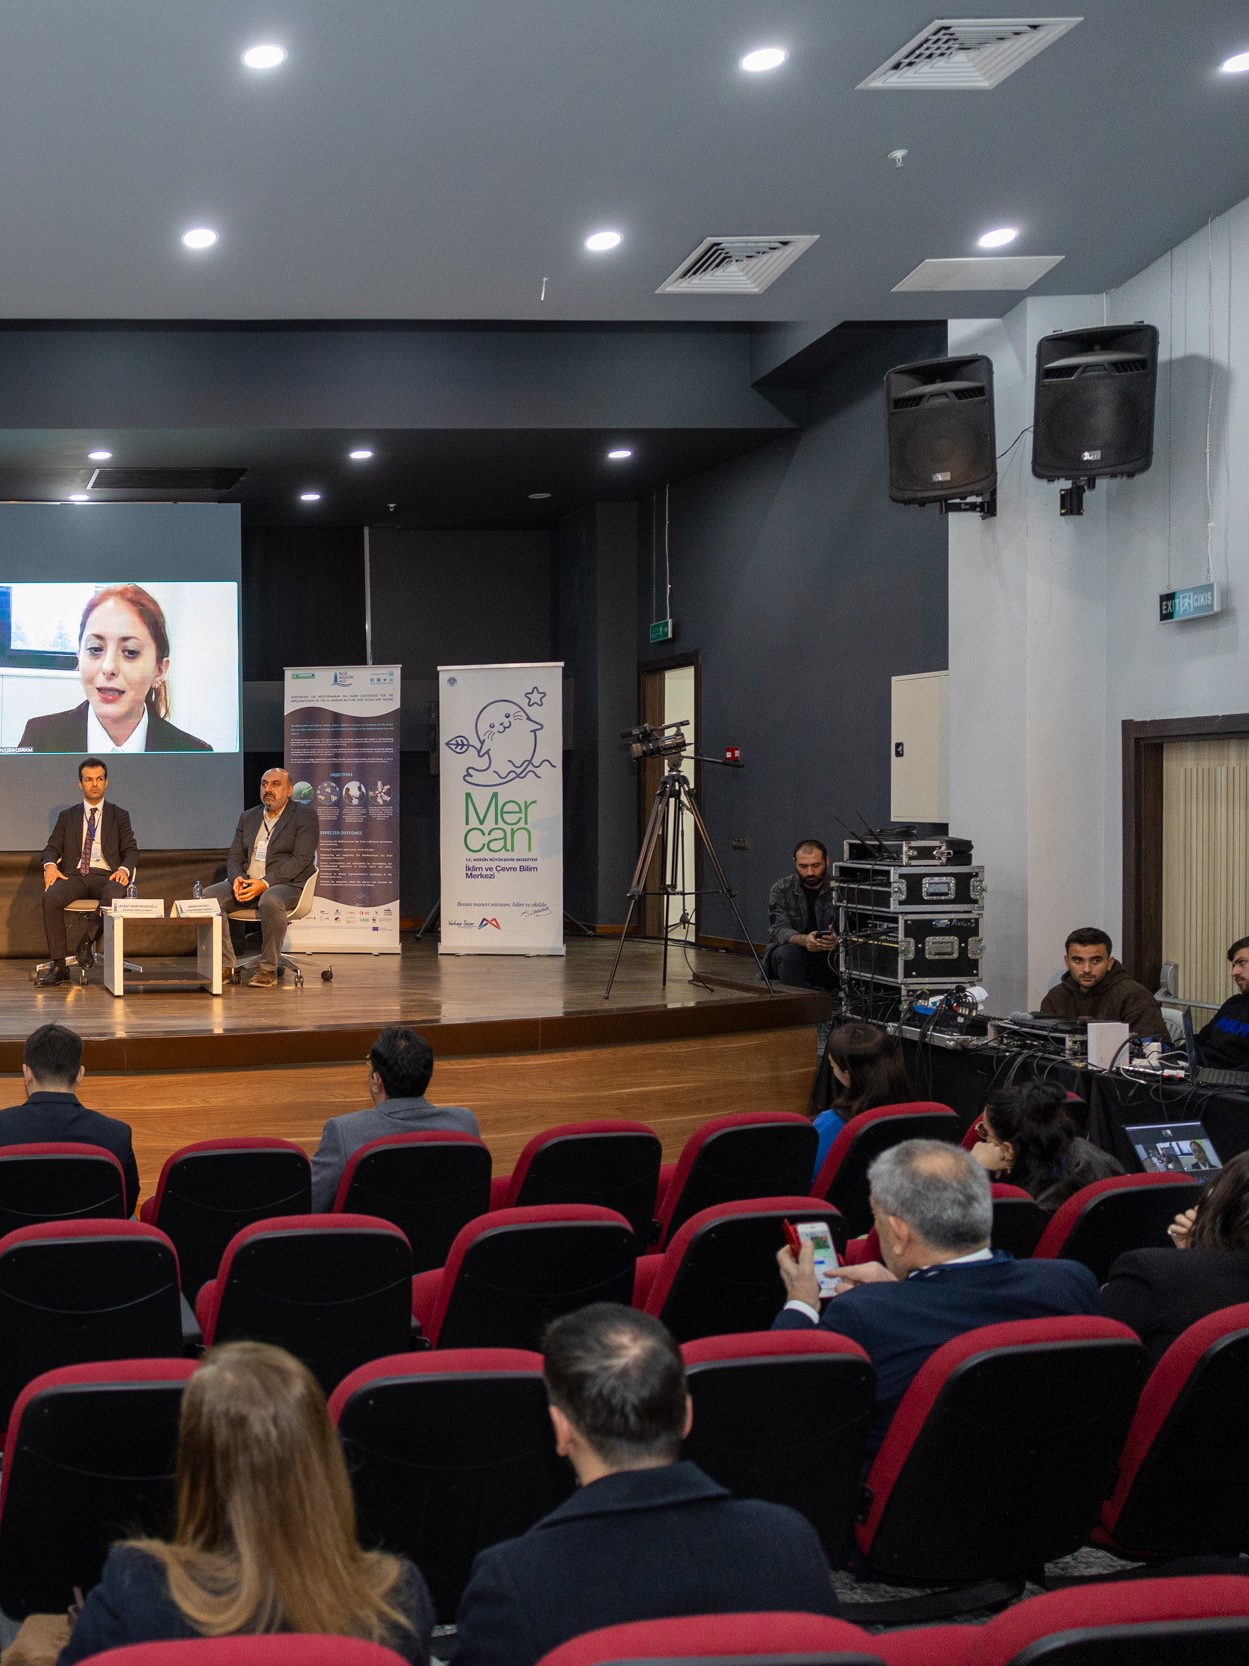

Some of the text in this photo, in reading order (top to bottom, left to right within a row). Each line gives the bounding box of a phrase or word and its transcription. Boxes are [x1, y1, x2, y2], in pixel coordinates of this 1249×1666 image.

[1162, 598, 1180, 615] EXIT
[465, 792, 537, 826] Mer
[463, 827, 532, 853] can
[465, 864, 483, 872] İklim
[495, 865, 517, 873] Çevre
[519, 864, 538, 872] Bilim
